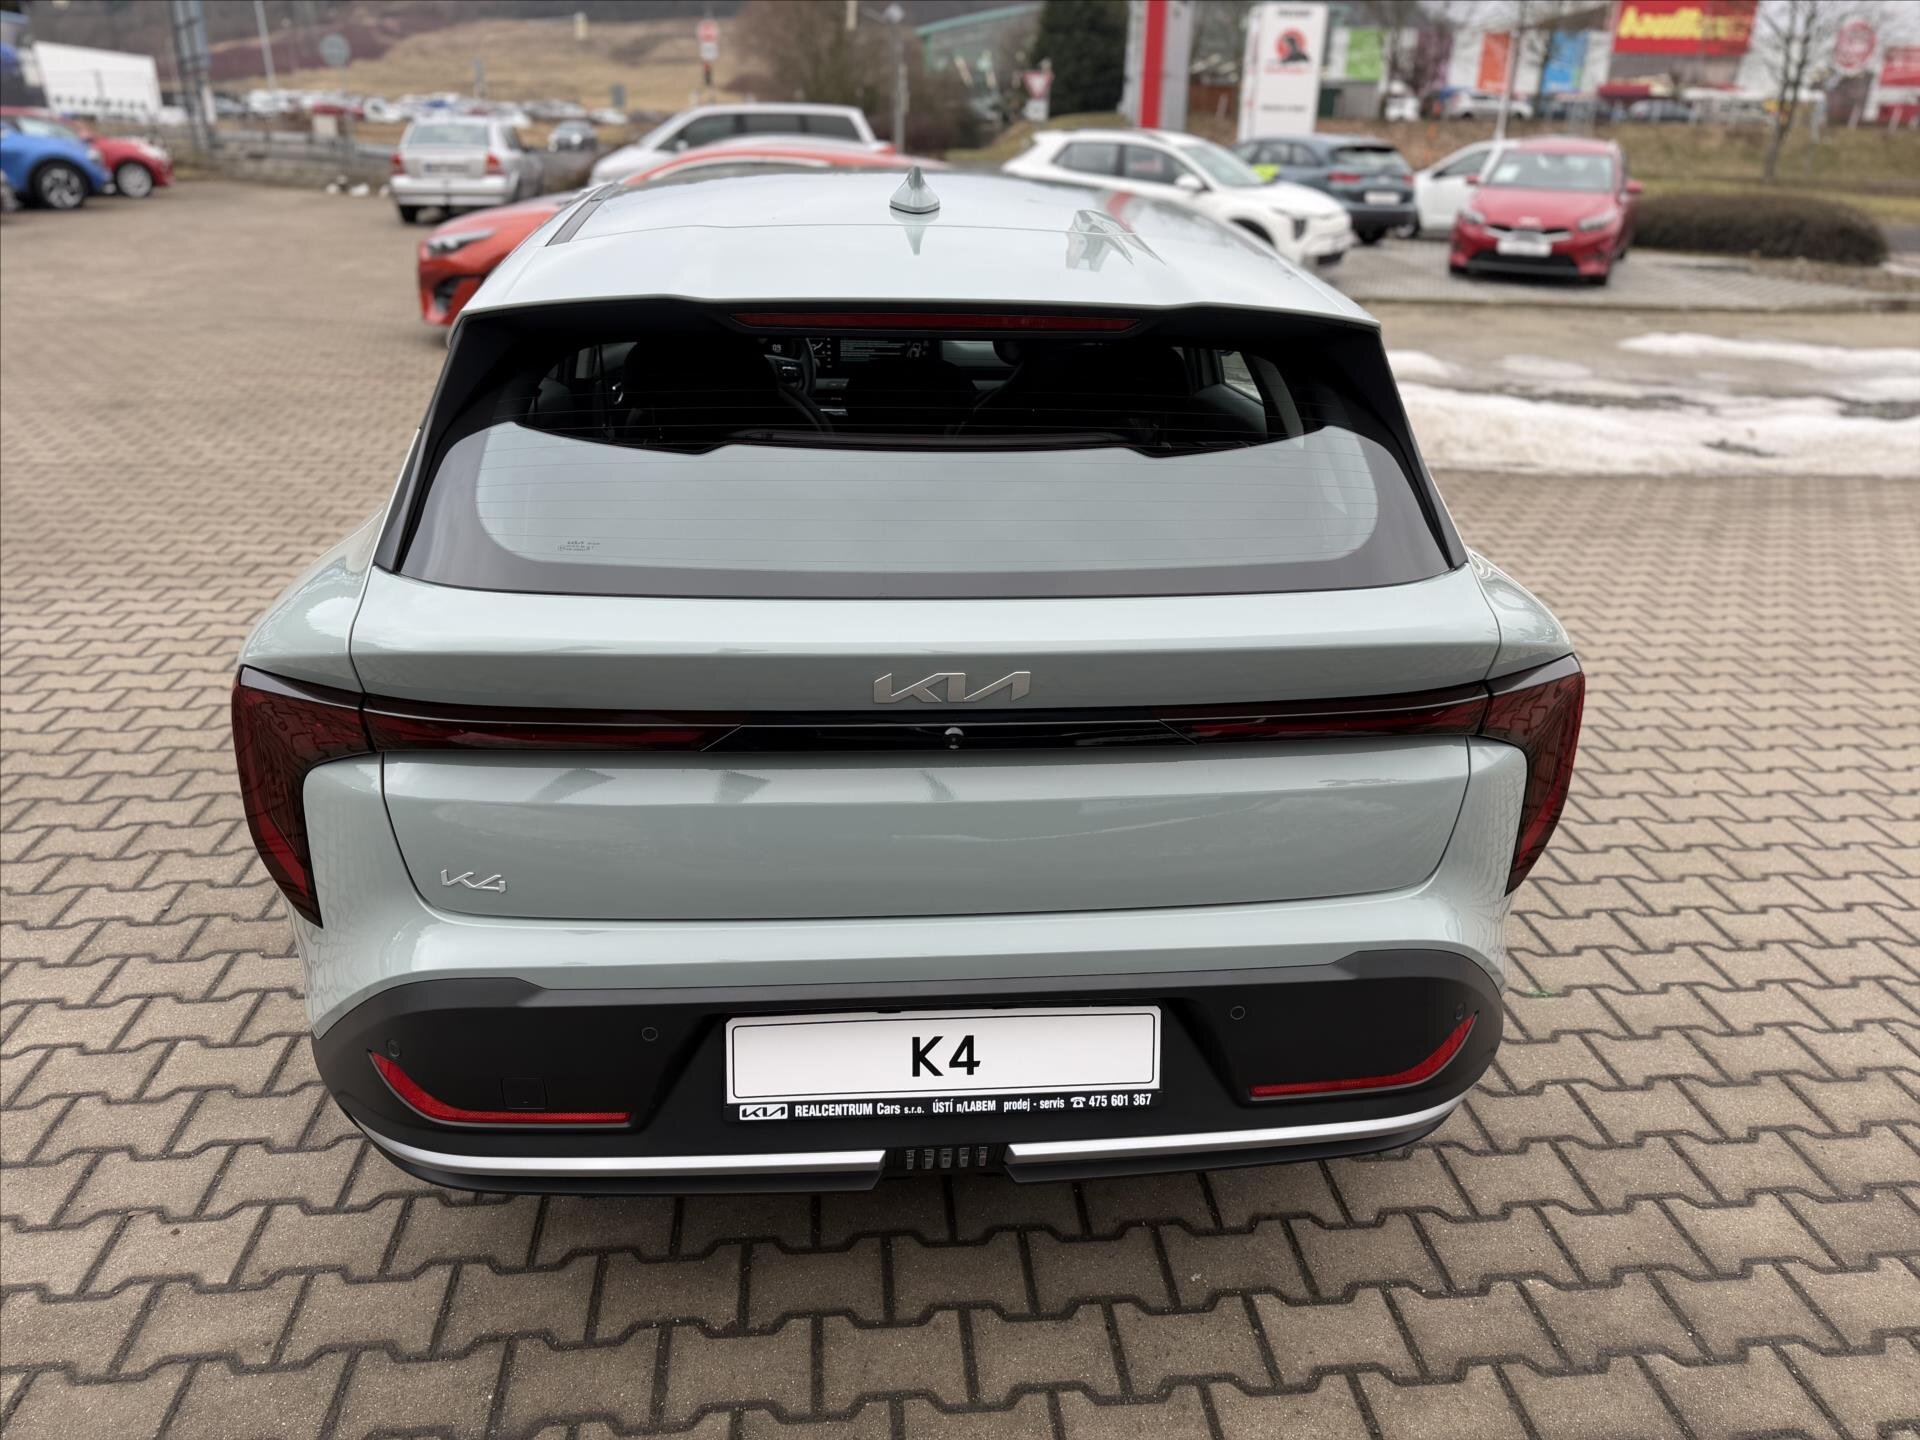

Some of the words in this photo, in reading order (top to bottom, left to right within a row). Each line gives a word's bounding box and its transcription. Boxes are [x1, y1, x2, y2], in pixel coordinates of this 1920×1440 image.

[873, 671, 1031, 704] KIA
[440, 869, 506, 893] K4
[911, 1034, 981, 1077] K4
[741, 1105, 786, 1119] KIA
[795, 1102, 873, 1117] REALCENTRUM
[876, 1102, 901, 1115] Cars
[904, 1105, 925, 1115] s.r.o.
[932, 1098, 954, 1113] ÚSTÍ
[956, 1099, 996, 1114] n/LABEM
[1003, 1098, 1030, 1113] prodej
[1039, 1097, 1065, 1110] servis
[1088, 1095, 1107, 1107] 475
[1111, 1094, 1129, 1107] 601
[1133, 1093, 1152, 1106] 367
